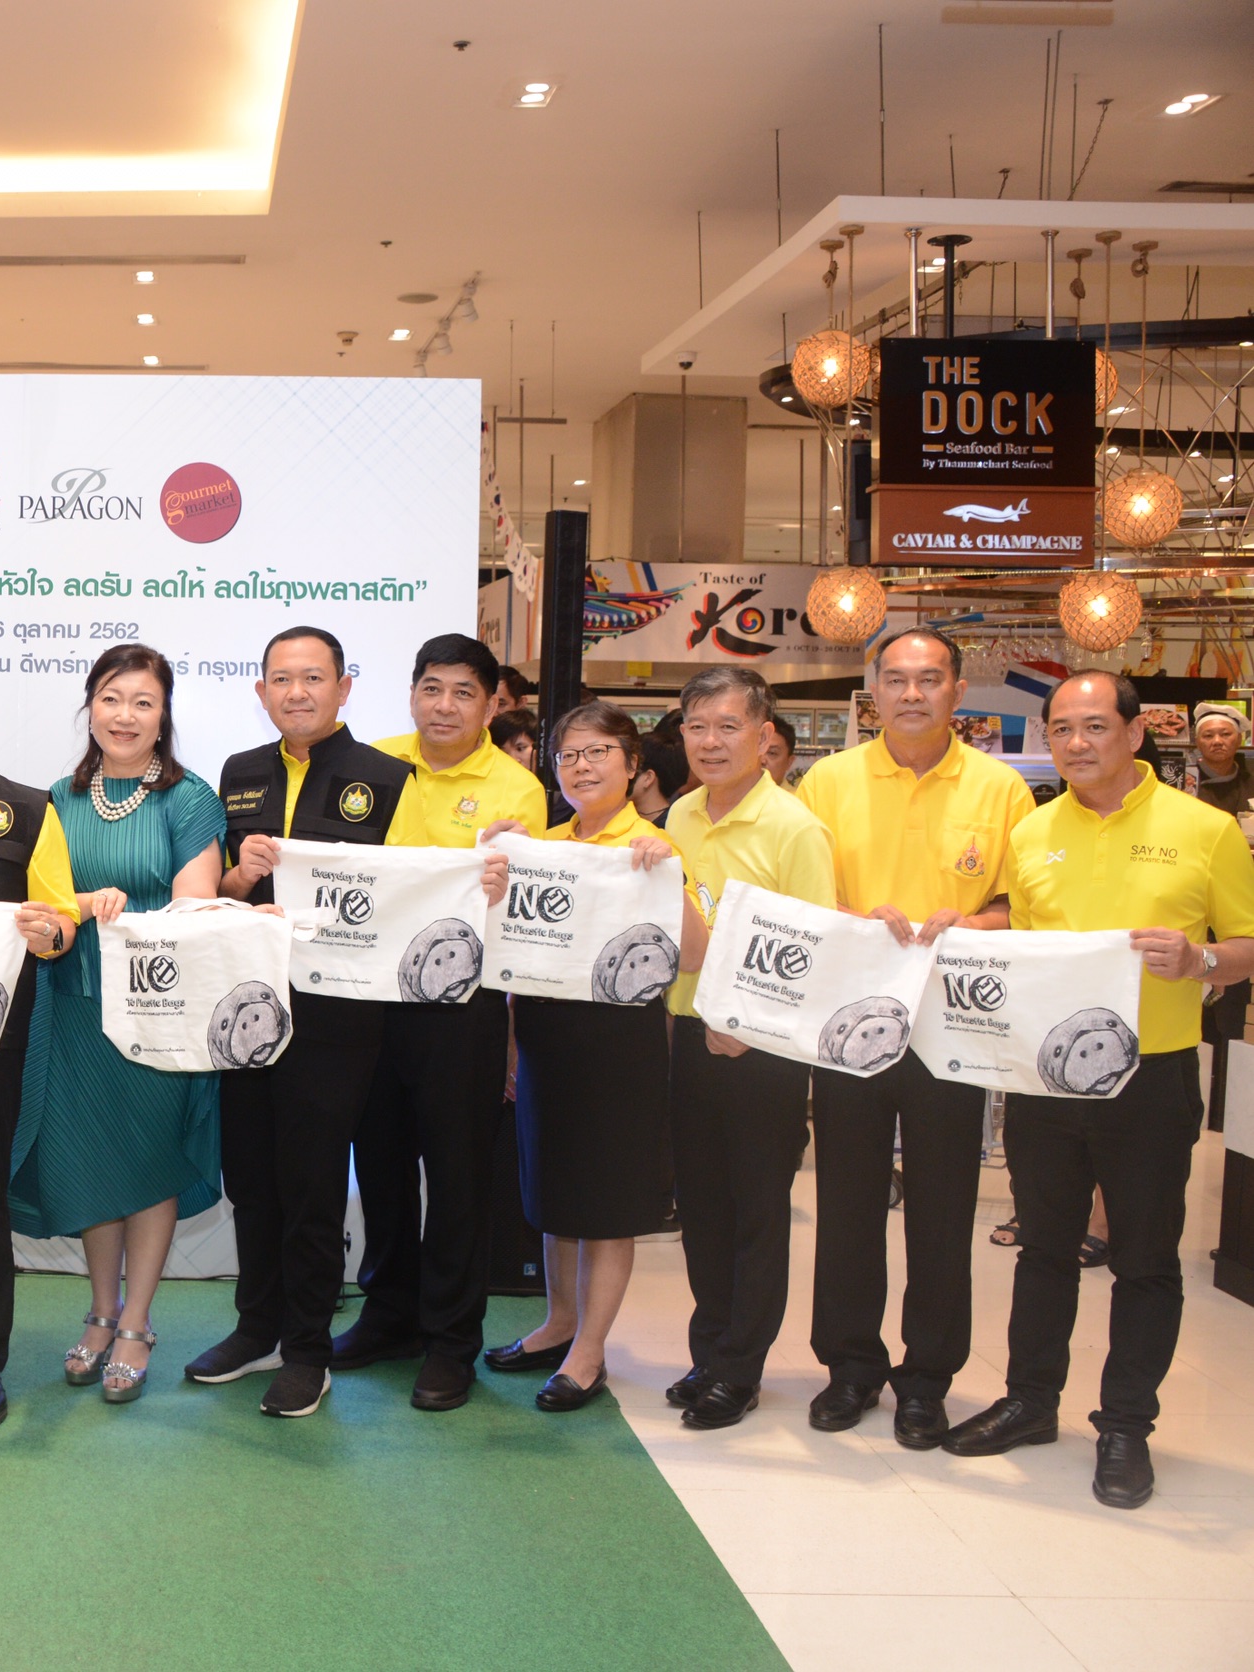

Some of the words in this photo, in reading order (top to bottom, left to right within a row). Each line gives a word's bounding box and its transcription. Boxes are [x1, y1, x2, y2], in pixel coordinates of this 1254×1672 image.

[922, 356, 980, 385] THE
[922, 390, 1054, 435] DOCK
[945, 441, 1002, 455] Seafood
[1004, 443, 1030, 455] Bar
[922, 458, 935, 470] By
[937, 459, 1009, 470] Thammachart
[1012, 460, 1053, 470] Seafood
[17, 494, 143, 521] PARAGON
[184, 492, 236, 515] market
[892, 533, 957, 549] CAVIAR
[959, 533, 974, 549] &
[976, 534, 1083, 550] CHAMPAGNE
[63, 571, 132, 598] ลดรับ
[143, 566, 206, 599] ลดให้
[699, 572, 744, 585] Taste
[749, 573, 766, 585] of
[13, 622, 81, 643] ตุลาคม
[89, 622, 140, 640] 2562
[1131, 844, 1155, 856] SAY
[1159, 847, 1178, 859] NO
[320, 928, 352, 941] Plastic
[353, 930, 378, 943] Bags
[513, 924, 547, 937] Plastic
[548, 929, 574, 942] Bags
[747, 976, 780, 993] Plastic
[781, 986, 805, 1001] Bags
[136, 998, 161, 1008] Plastic
[162, 998, 186, 1010] Bags
[955, 1013, 986, 1026] Plastic
[987, 1018, 1010, 1032] Bags
